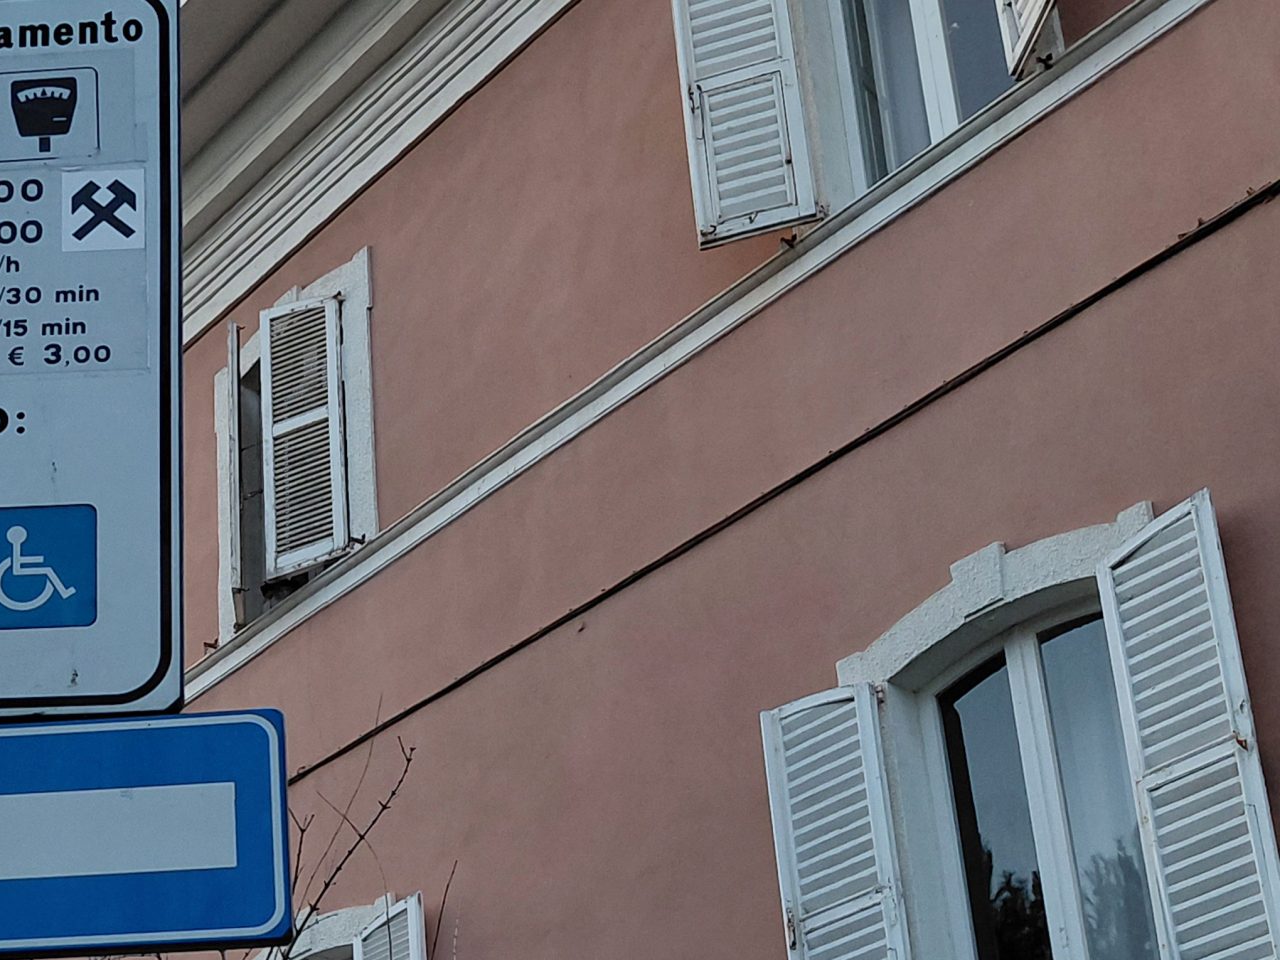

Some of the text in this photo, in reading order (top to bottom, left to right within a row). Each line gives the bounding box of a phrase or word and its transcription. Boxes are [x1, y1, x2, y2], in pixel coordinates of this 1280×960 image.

[55, 284, 100, 303] min
[41, 317, 86, 336] min
[7, 346, 25, 366] €
[43, 343, 111, 367] 3,00
